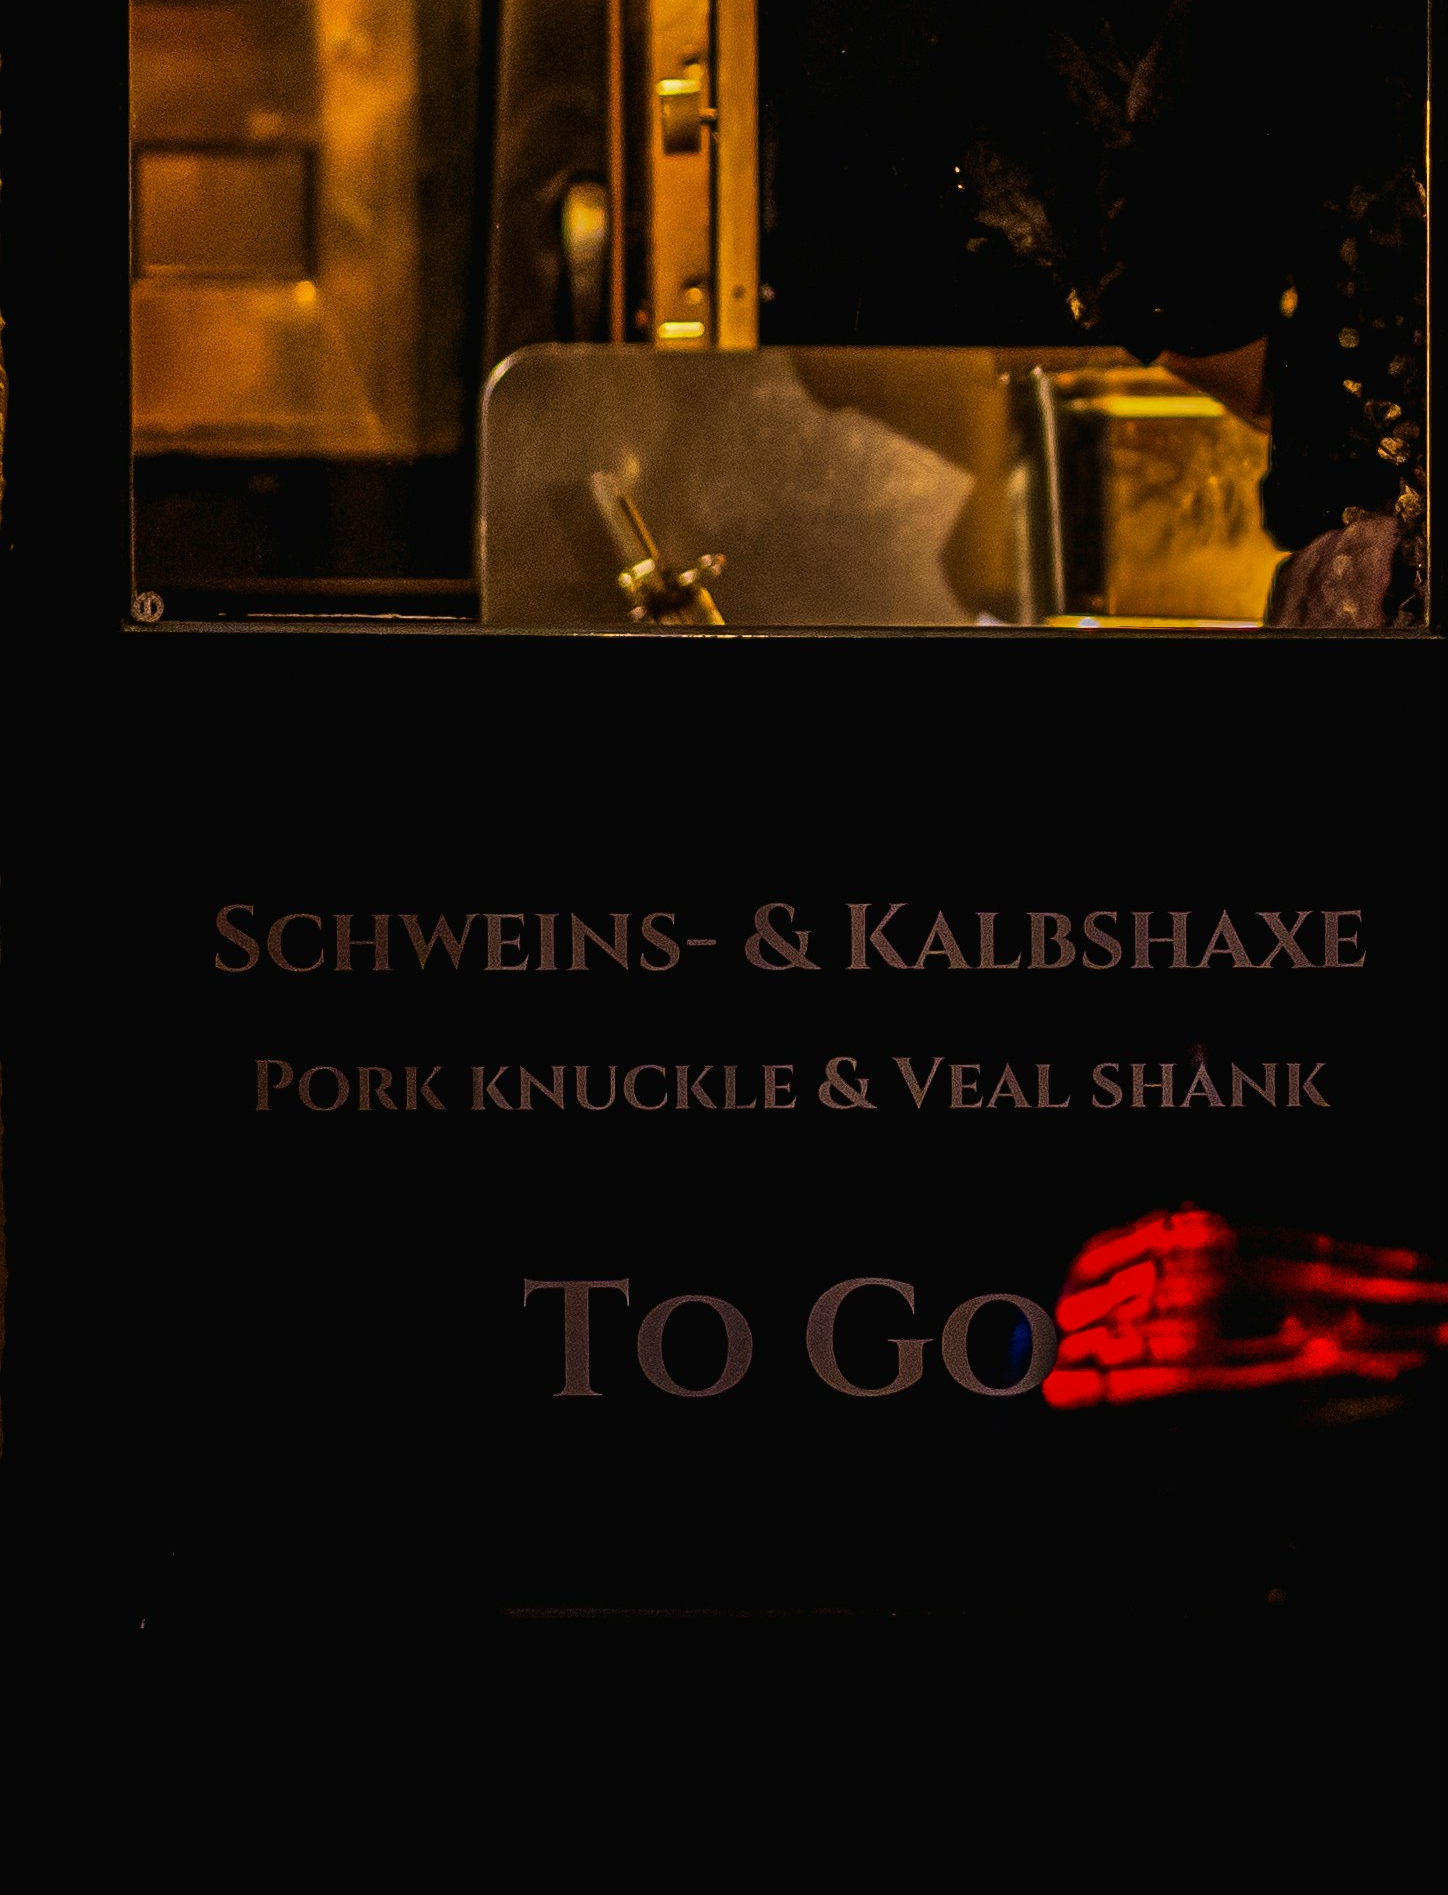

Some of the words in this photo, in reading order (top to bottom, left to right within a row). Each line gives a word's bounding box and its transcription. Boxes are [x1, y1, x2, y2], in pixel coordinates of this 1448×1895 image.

[213, 902, 718, 974] SCHWEINS-
[744, 901, 822, 972] &
[846, 901, 1368, 971] KALBSHAXE
[255, 1058, 446, 1113] PORK
[470, 1062, 798, 1112] KNUCKLE
[816, 1054, 877, 1112] &
[893, 1055, 1072, 1111] VEAL
[1090, 1058, 1332, 1111] SHANK
[522, 1277, 754, 1399] TO
[804, 1276, 1060, 1399] GO
